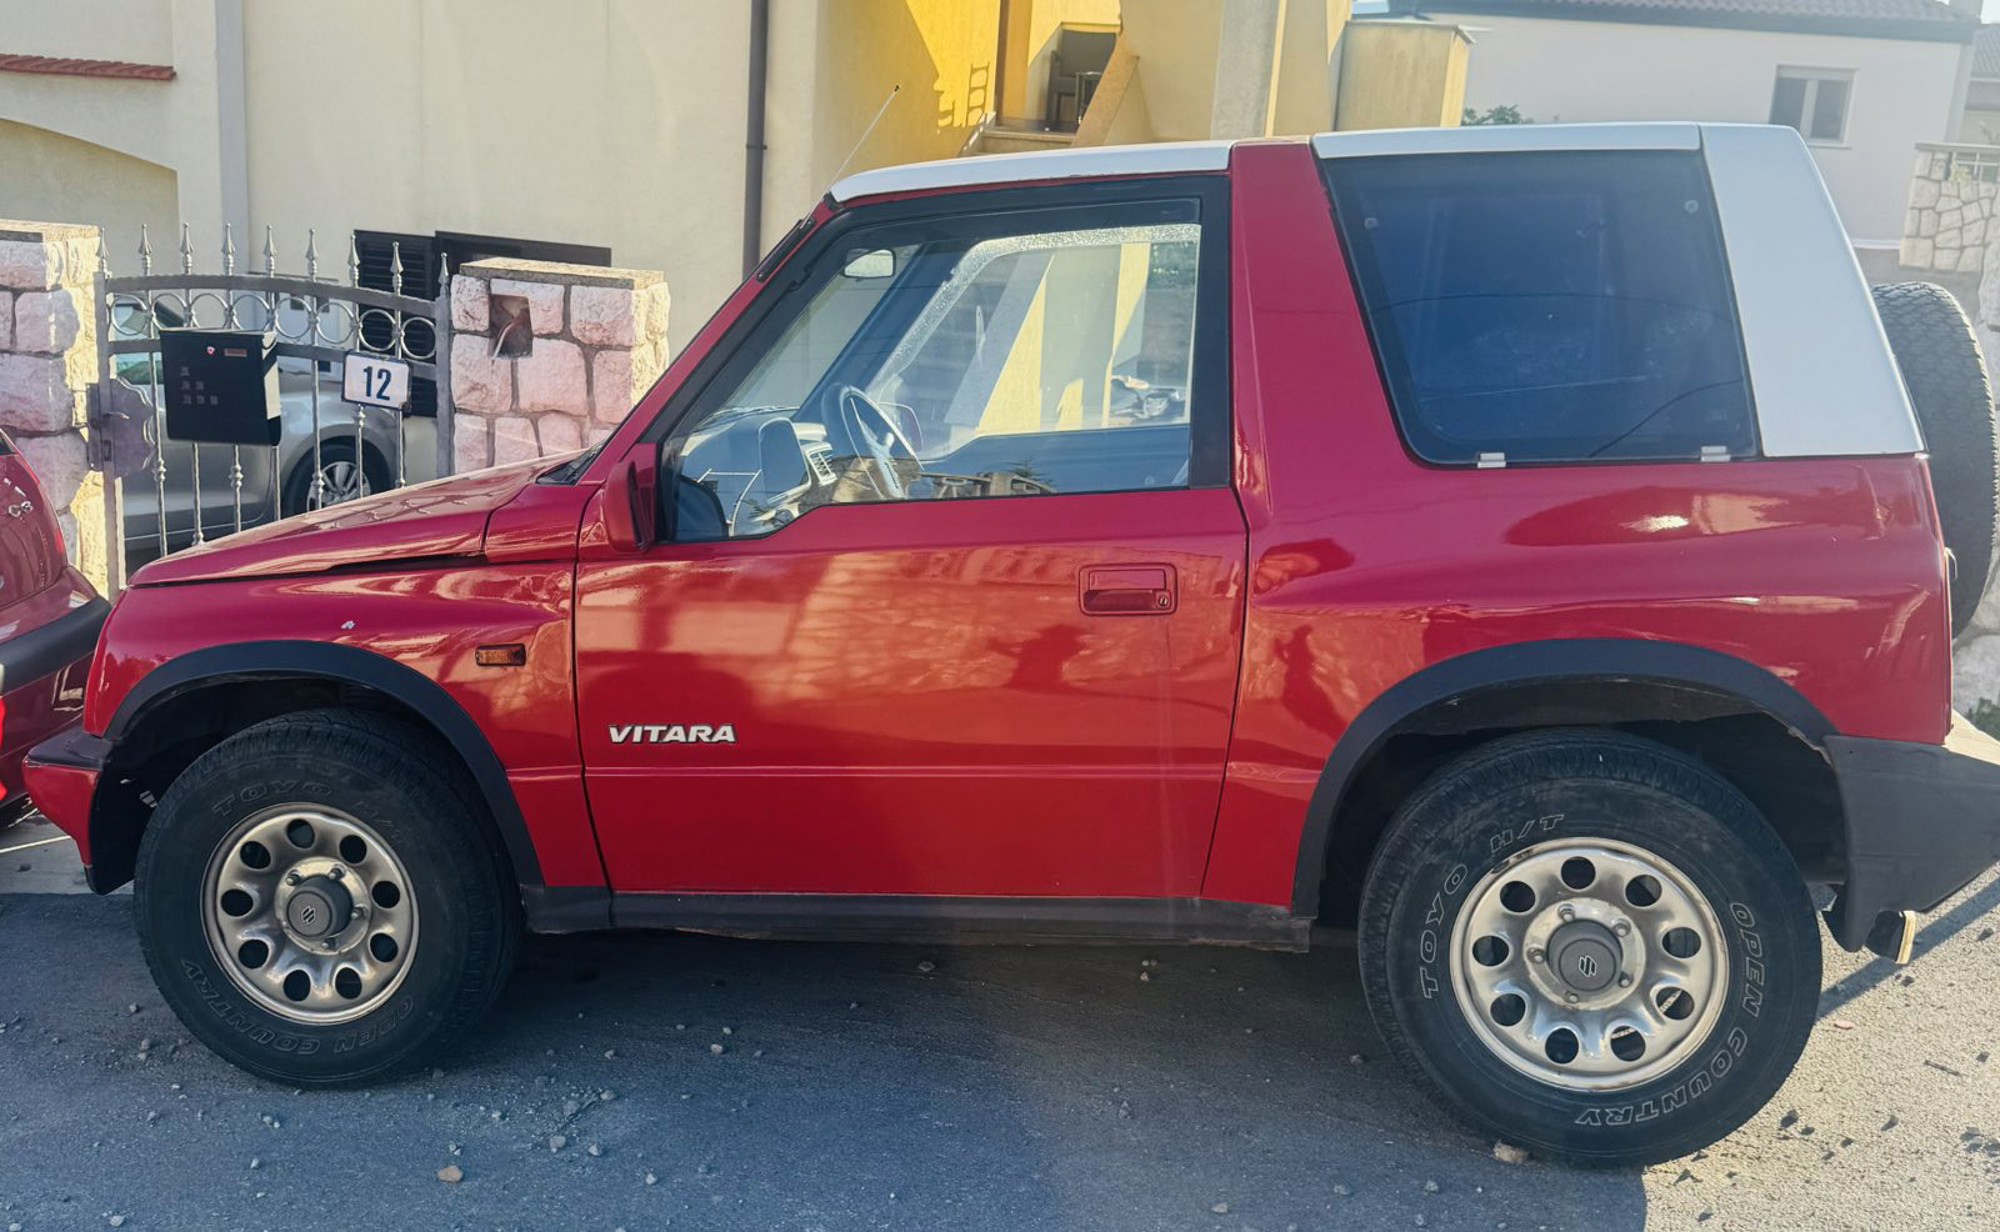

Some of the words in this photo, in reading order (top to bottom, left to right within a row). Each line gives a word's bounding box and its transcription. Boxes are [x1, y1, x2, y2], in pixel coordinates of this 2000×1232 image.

[363, 365, 392, 401] 12
[609, 725, 737, 743] VITARA
[211, 779, 333, 816] TOYO
[1490, 814, 1565, 853] H/T
[1420, 863, 1468, 999] TOYO
[1730, 902, 1765, 1018] OPEN
[181, 958, 321, 1055] COUNTRY
[333, 994, 414, 1054] OPEN
[1575, 1027, 1748, 1126] COUNTRY
